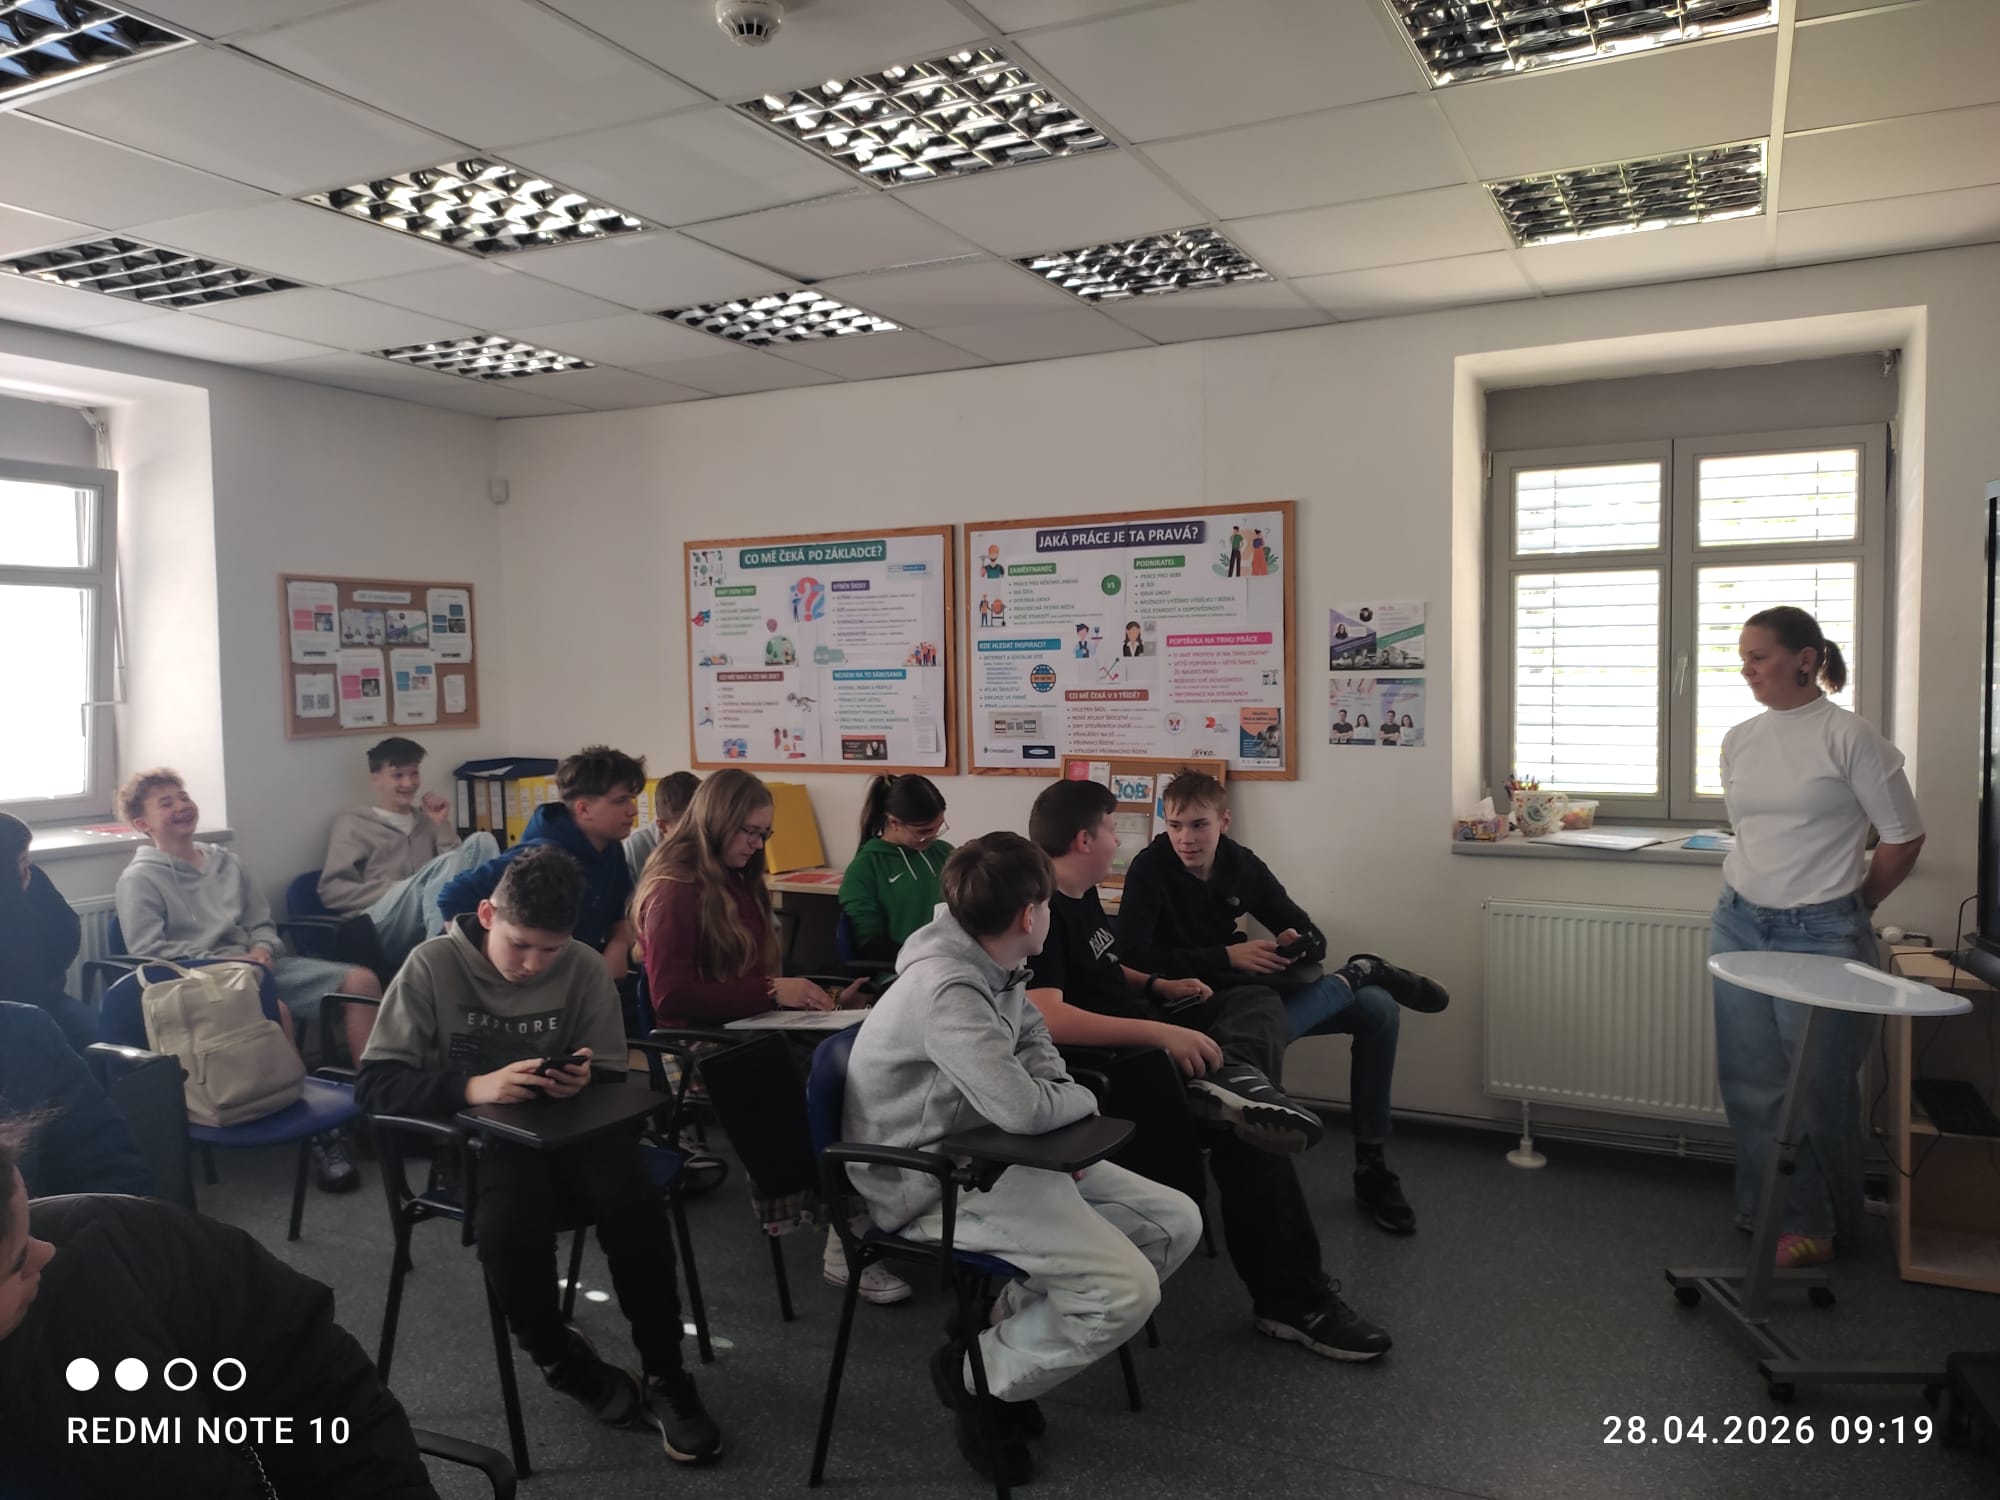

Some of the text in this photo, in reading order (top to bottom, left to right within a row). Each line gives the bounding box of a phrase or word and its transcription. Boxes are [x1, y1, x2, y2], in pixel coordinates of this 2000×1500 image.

[1039, 524, 1199, 548] JAKÁ PRÁCE JE TA PRAVÁ?
[744, 545, 883, 565] CO MĚ ČEKÁ PO ZÁKLADCE?
[1136, 559, 1176, 567] PODNIKATEL
[1009, 565, 1053, 574] ZAMĚSTNANEC
[992, 641, 1014, 649] HLEDAT
